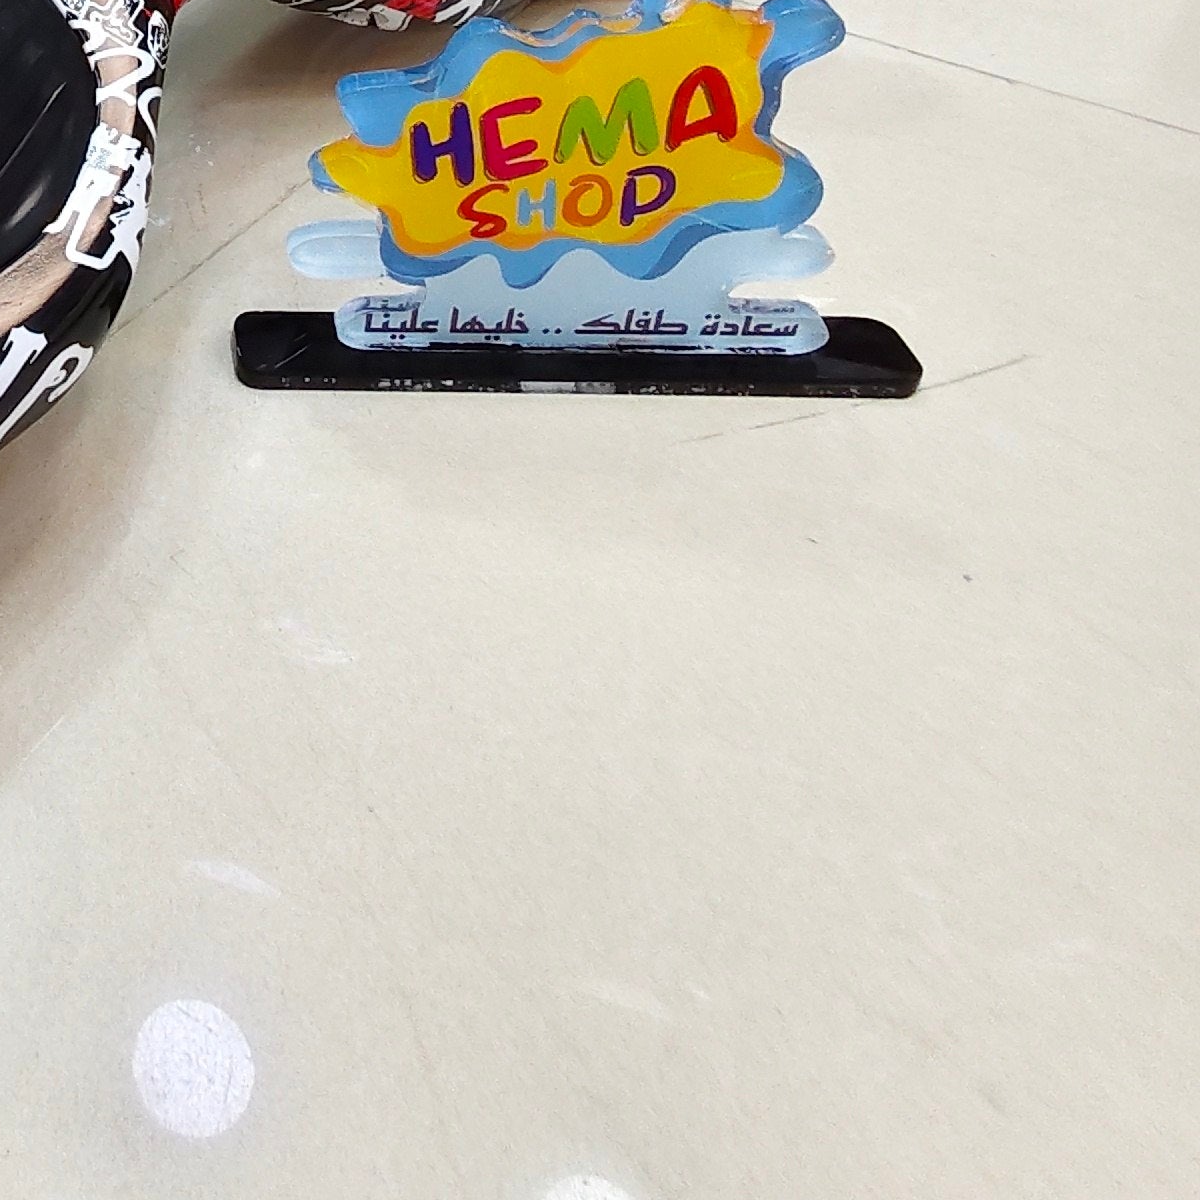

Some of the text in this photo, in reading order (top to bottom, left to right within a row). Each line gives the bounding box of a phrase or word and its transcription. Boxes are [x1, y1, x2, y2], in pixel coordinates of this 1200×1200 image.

[410, 65, 738, 187] HEMA
[456, 164, 677, 239] SHOP
[364, 307, 440, 340] علينا
[450, 306, 529, 341] خليها
[574, 308, 689, 335] طفلك
[700, 313, 800, 337] سعادة
